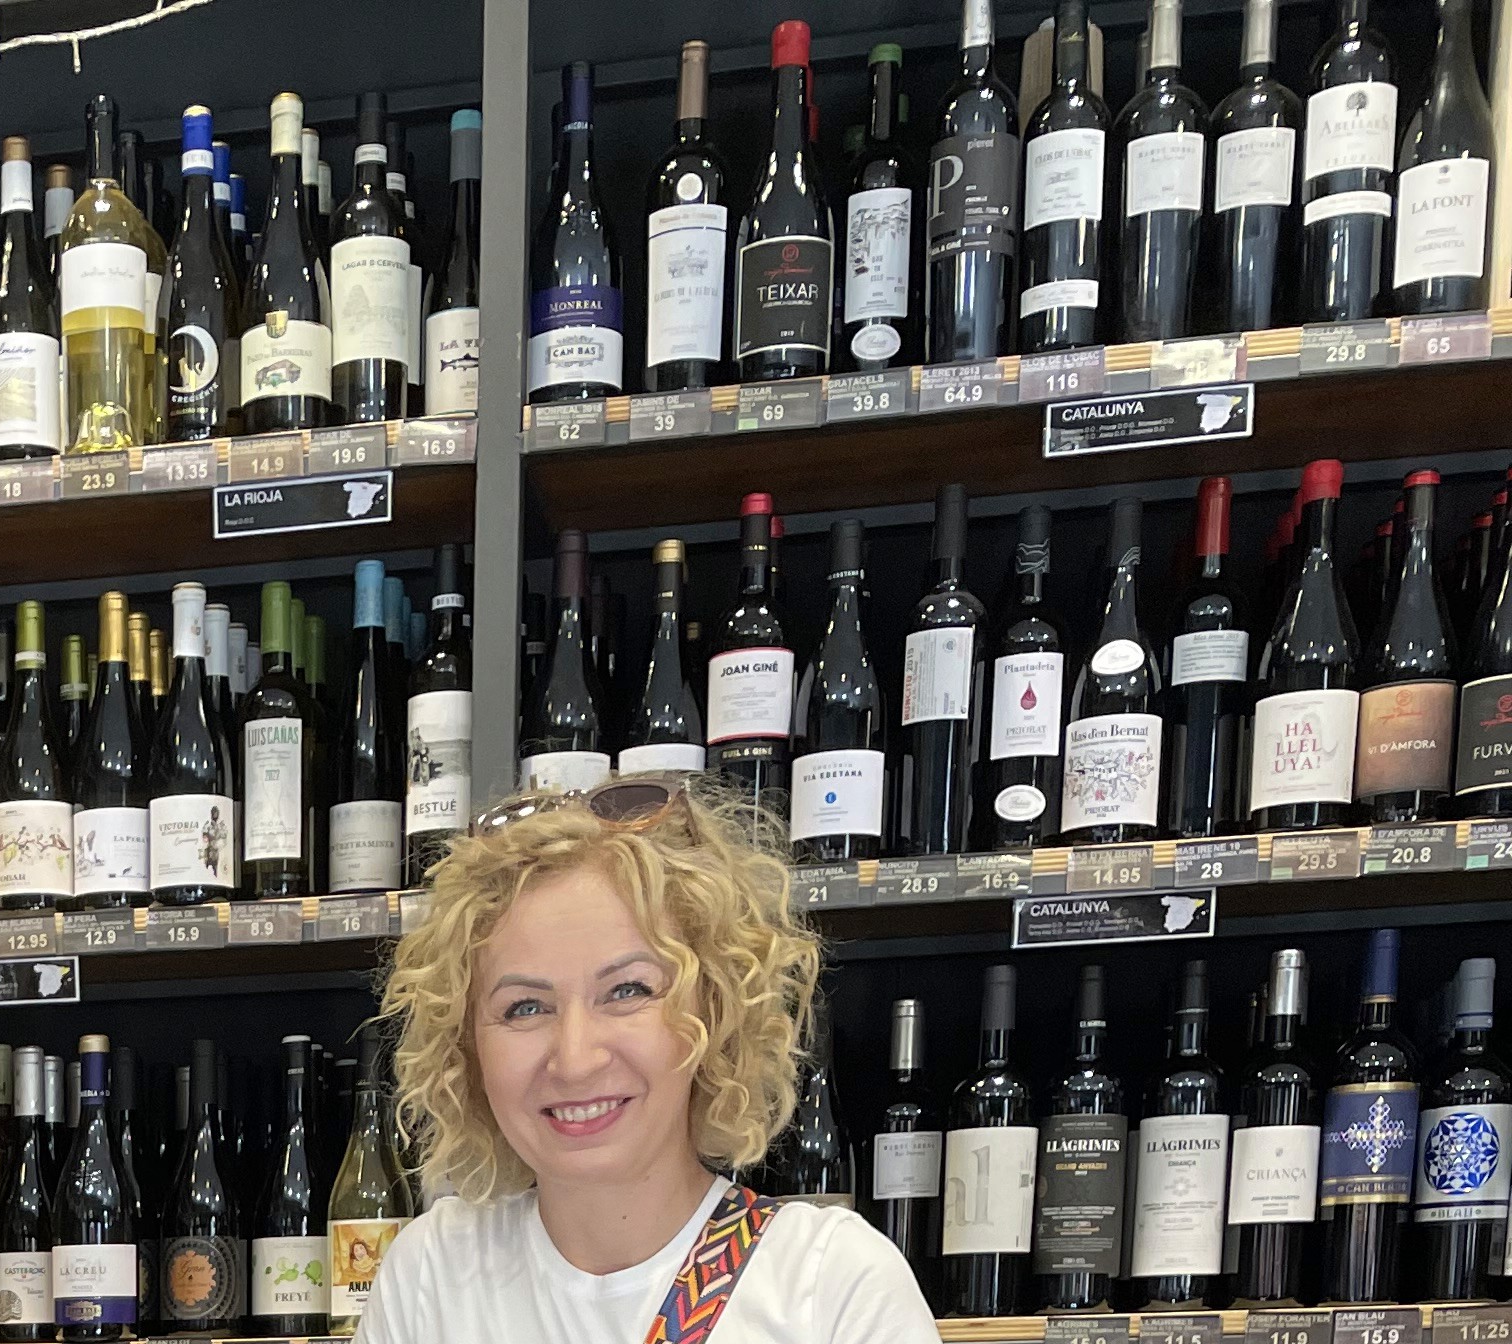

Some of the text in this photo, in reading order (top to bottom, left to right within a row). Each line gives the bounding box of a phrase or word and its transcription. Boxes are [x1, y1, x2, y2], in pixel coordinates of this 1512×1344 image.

[1411, 193, 1473, 215] LA FONT
[756, 284, 819, 301] TEIXAR
[549, 299, 603, 312] MONREAL
[574, 346, 596, 358] BAS
[1326, 345, 1366, 361] 29.8
[1427, 338, 1450, 354] 65
[1046, 373, 1078, 391] 116
[852, 393, 890, 412] 39.8
[944, 385, 983, 403] 64.9
[763, 403, 784, 420] 69
[1061, 401, 1144, 422] CATALUNYA
[654, 414, 674, 431] 39
[559, 424, 580, 440] 62
[331, 446, 366, 464] 19.6
[422, 440, 456, 457] 16.9
[166, 462, 208, 481] 13.35
[251, 456, 284, 474] 14.9
[82, 472, 115, 490] 23.9
[3, 482, 22, 498] 18
[224, 489, 283, 507] LA RIOJA
[720, 660, 779, 678] JOAN GINÉ
[1111, 722, 1150, 739] Bernat
[1285, 722, 1313, 737] HA
[1275, 738, 1322, 755] LLEL
[1274, 755, 1322, 772] UYA!
[413, 798, 457, 814] BESTUÉ
[1298, 852, 1337, 870] 29.5
[1391, 846, 1431, 865] 20.8
[1093, 867, 1141, 884] 14.95
[1201, 861, 1223, 879] 28
[901, 877, 938, 894] 28.9
[982, 871, 1019, 889] 16.9
[809, 887, 828, 902] 21
[1030, 901, 1110, 917] CATALUNYA
[251, 920, 274, 938] 8.9
[342, 916, 361, 932] 16
[7, 933, 48, 949] 12.95
[85, 929, 117, 945] 12.9
[167, 927, 200, 943] 15.9
[1247, 1166, 1308, 1181] CRIANÇA
[79, 1265, 107, 1275] CREU
[1460, 1322, 1509, 1340] 11.25
